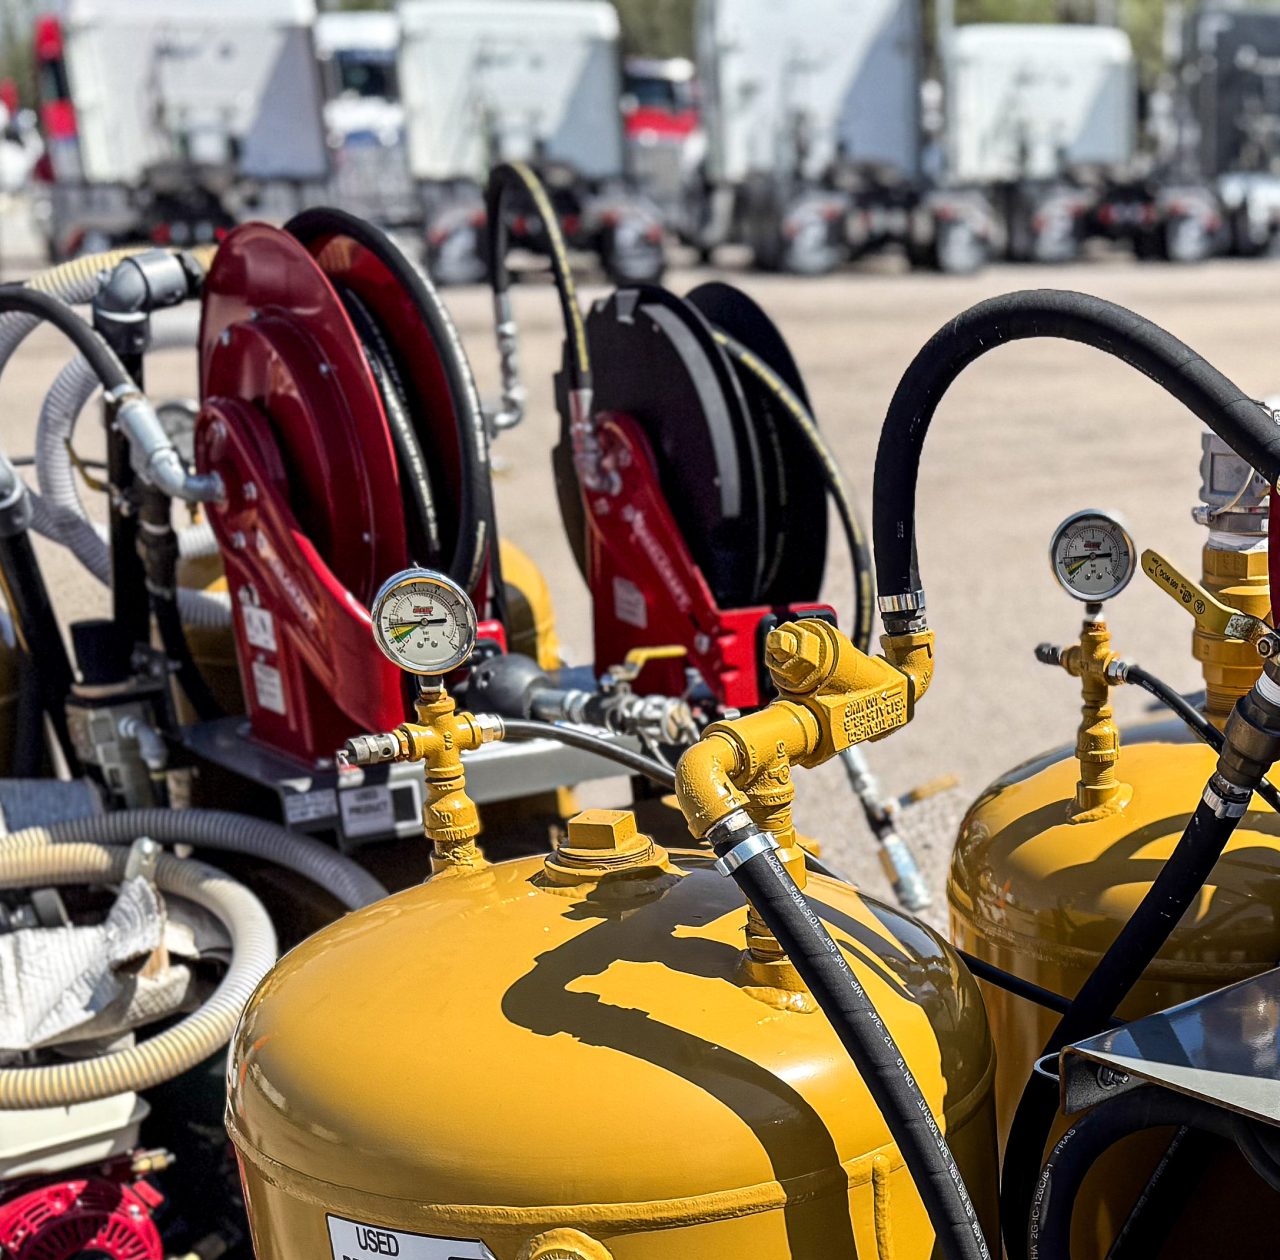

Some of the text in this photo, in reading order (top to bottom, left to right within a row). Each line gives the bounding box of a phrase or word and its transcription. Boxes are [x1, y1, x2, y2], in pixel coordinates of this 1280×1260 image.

[768, 855, 786, 878] 1520
[791, 886, 806, 909] MPa
[825, 936, 836, 952] bar
[835, 954, 848, 972] 105
[851, 980, 864, 997] WP
[355, 1226, 399, 1257] USED
